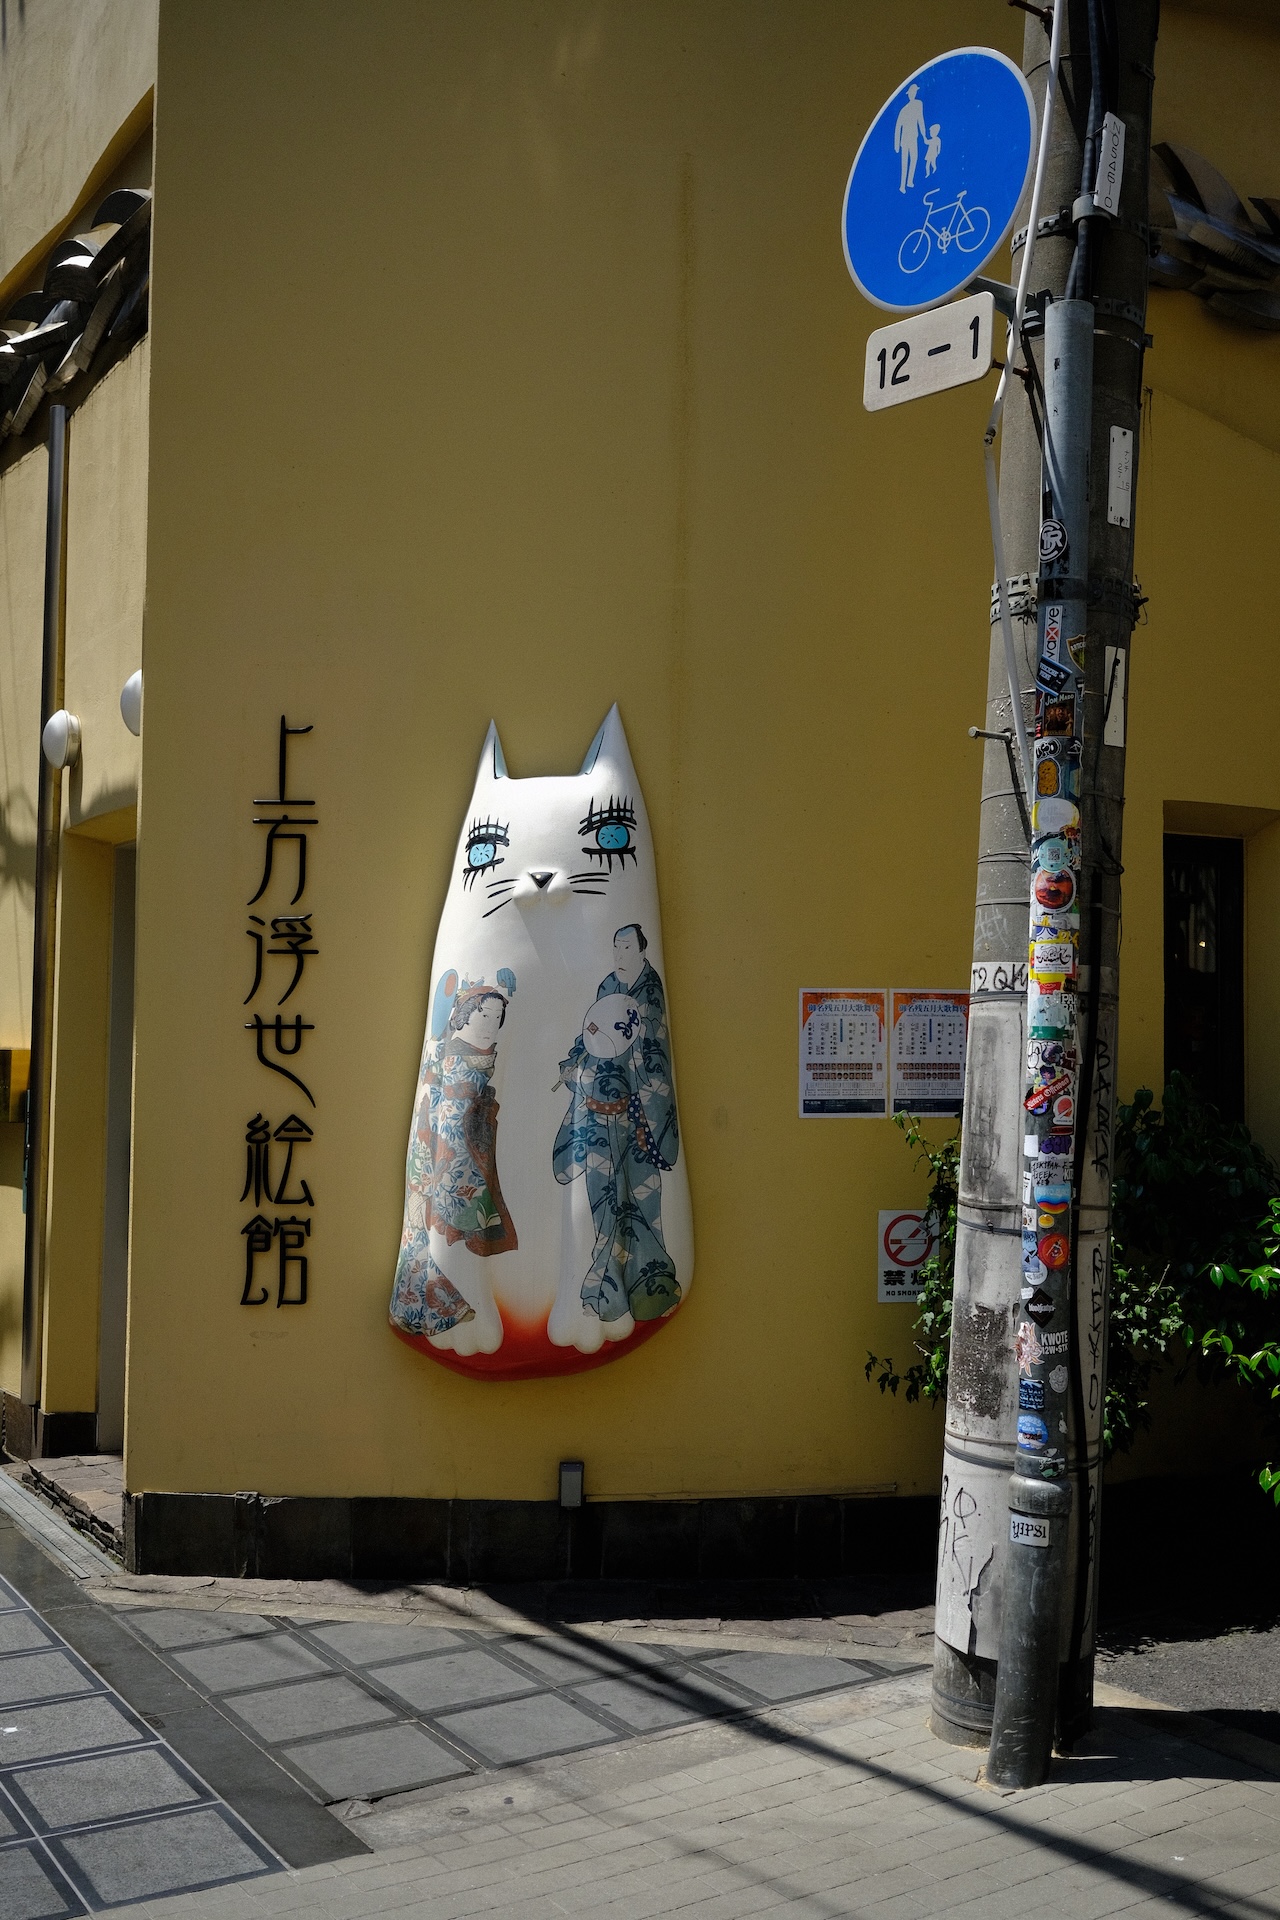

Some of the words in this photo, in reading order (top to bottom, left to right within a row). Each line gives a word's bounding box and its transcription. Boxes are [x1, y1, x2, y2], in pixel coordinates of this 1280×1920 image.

[240, 714, 319, 1309] 上方浮世絵館
[1041, 1330, 1068, 1346] KWOTE
